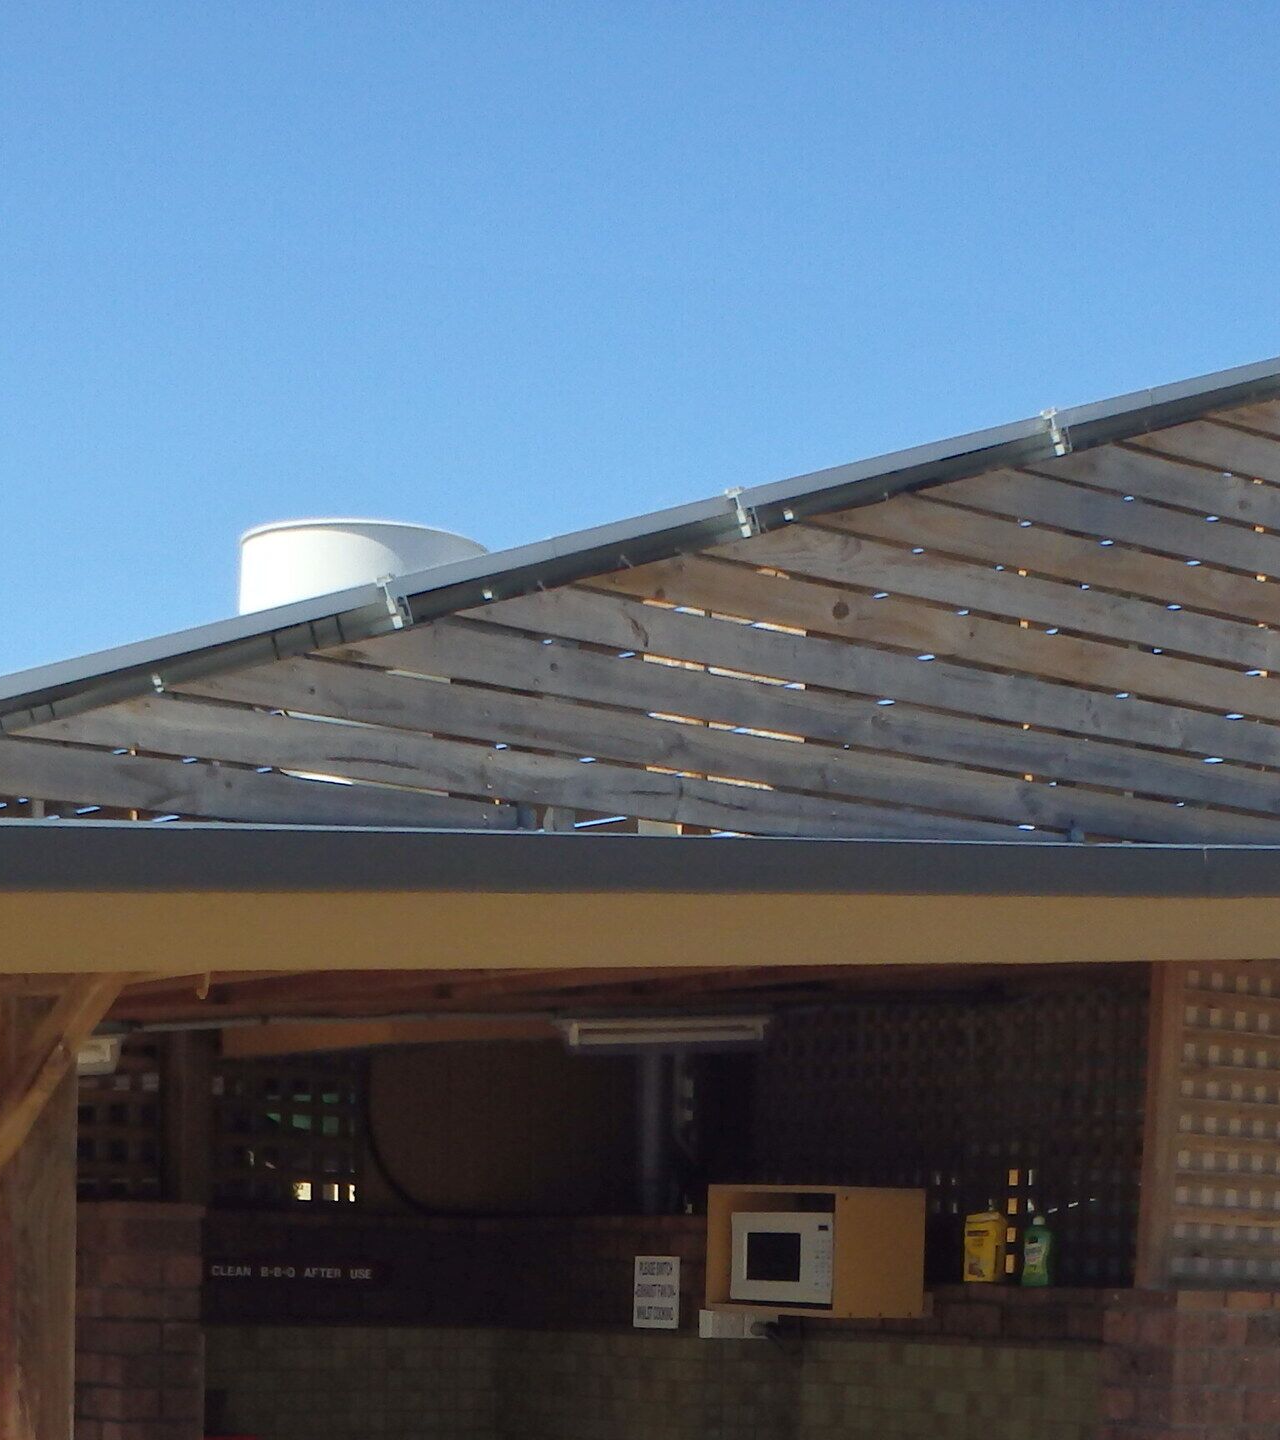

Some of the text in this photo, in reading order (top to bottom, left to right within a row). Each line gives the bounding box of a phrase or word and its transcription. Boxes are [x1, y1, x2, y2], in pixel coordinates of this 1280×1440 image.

[212, 1265, 251, 1276] CLEAN
[304, 1267, 341, 1278] AFTER
[350, 1268, 373, 1279] USE
